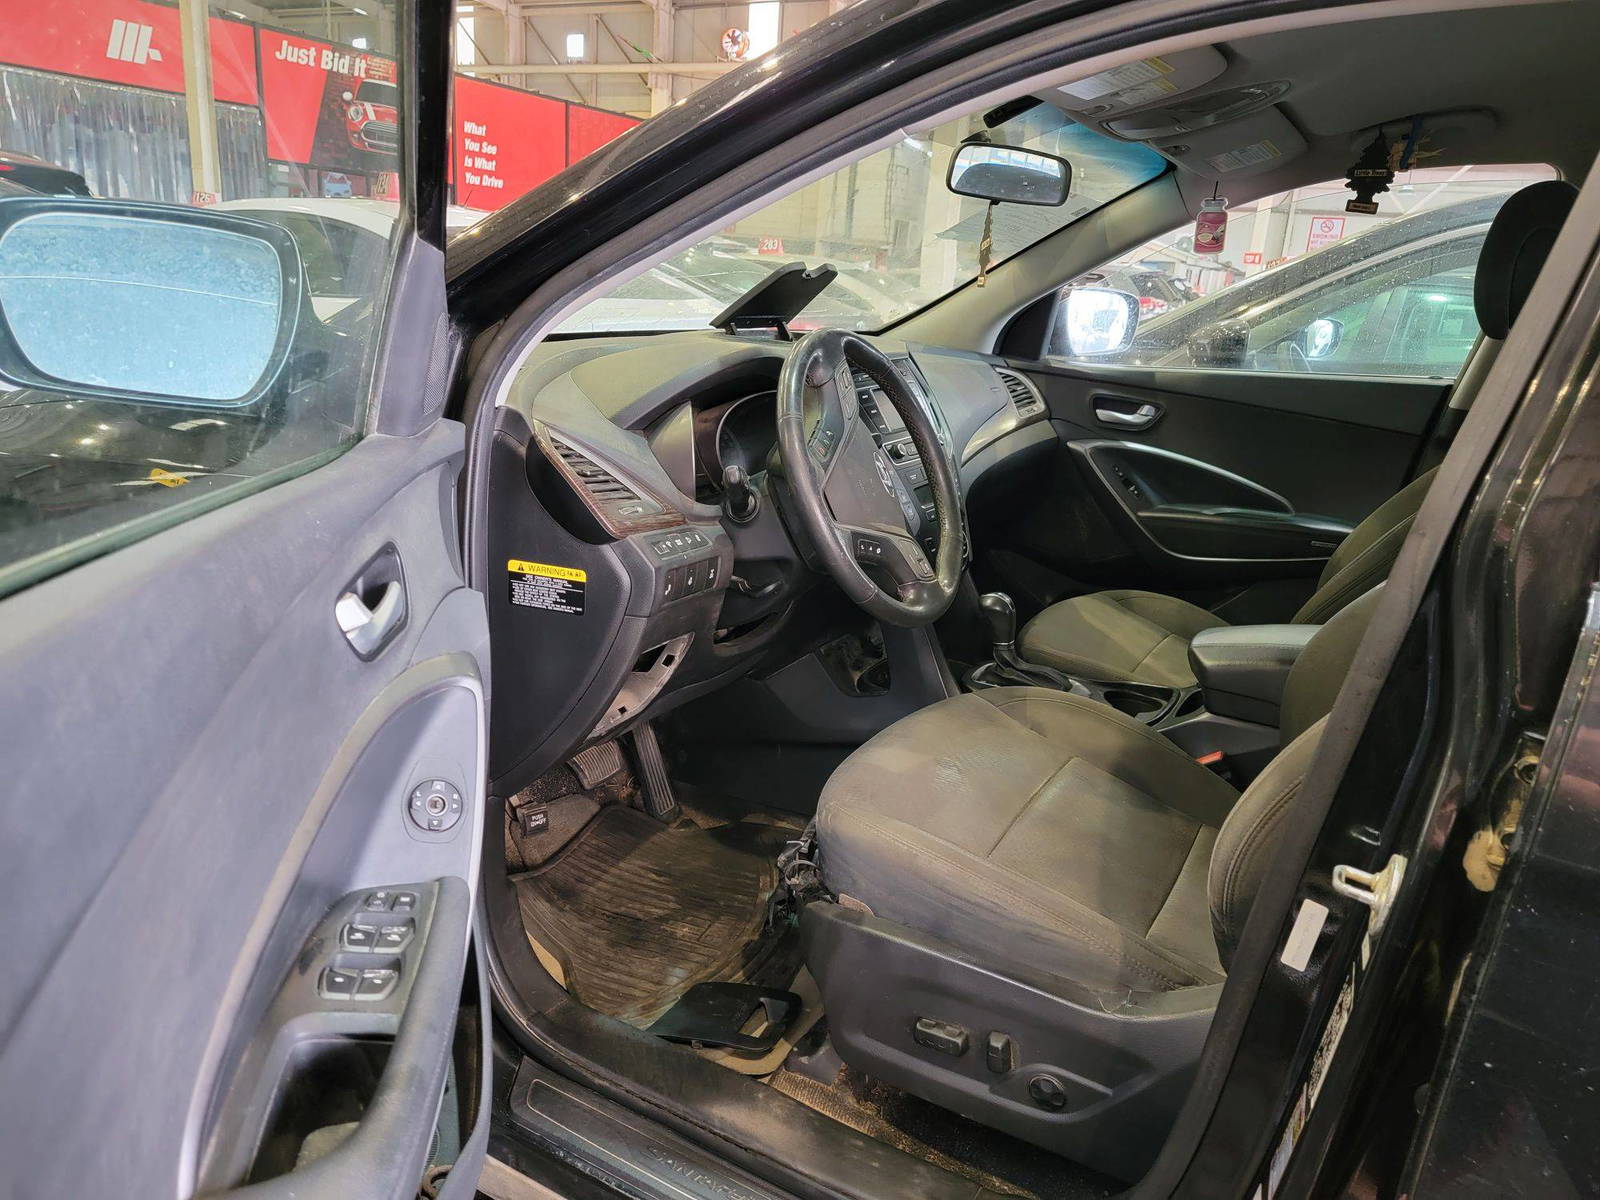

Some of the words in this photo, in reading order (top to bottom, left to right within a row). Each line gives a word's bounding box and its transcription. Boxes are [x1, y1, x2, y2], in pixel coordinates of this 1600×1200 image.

[275, 39, 317, 67] Just
[320, 49, 350, 75] Bid
[353, 56, 367, 79] It
[463, 120, 487, 137] What
[464, 137, 481, 153] You
[481, 141, 498, 156] See
[463, 154, 473, 167] Is
[474, 156, 497, 172] What
[465, 171, 481, 186] You
[481, 173, 504, 189] Drive
[528, 564, 566, 577] WARNING
